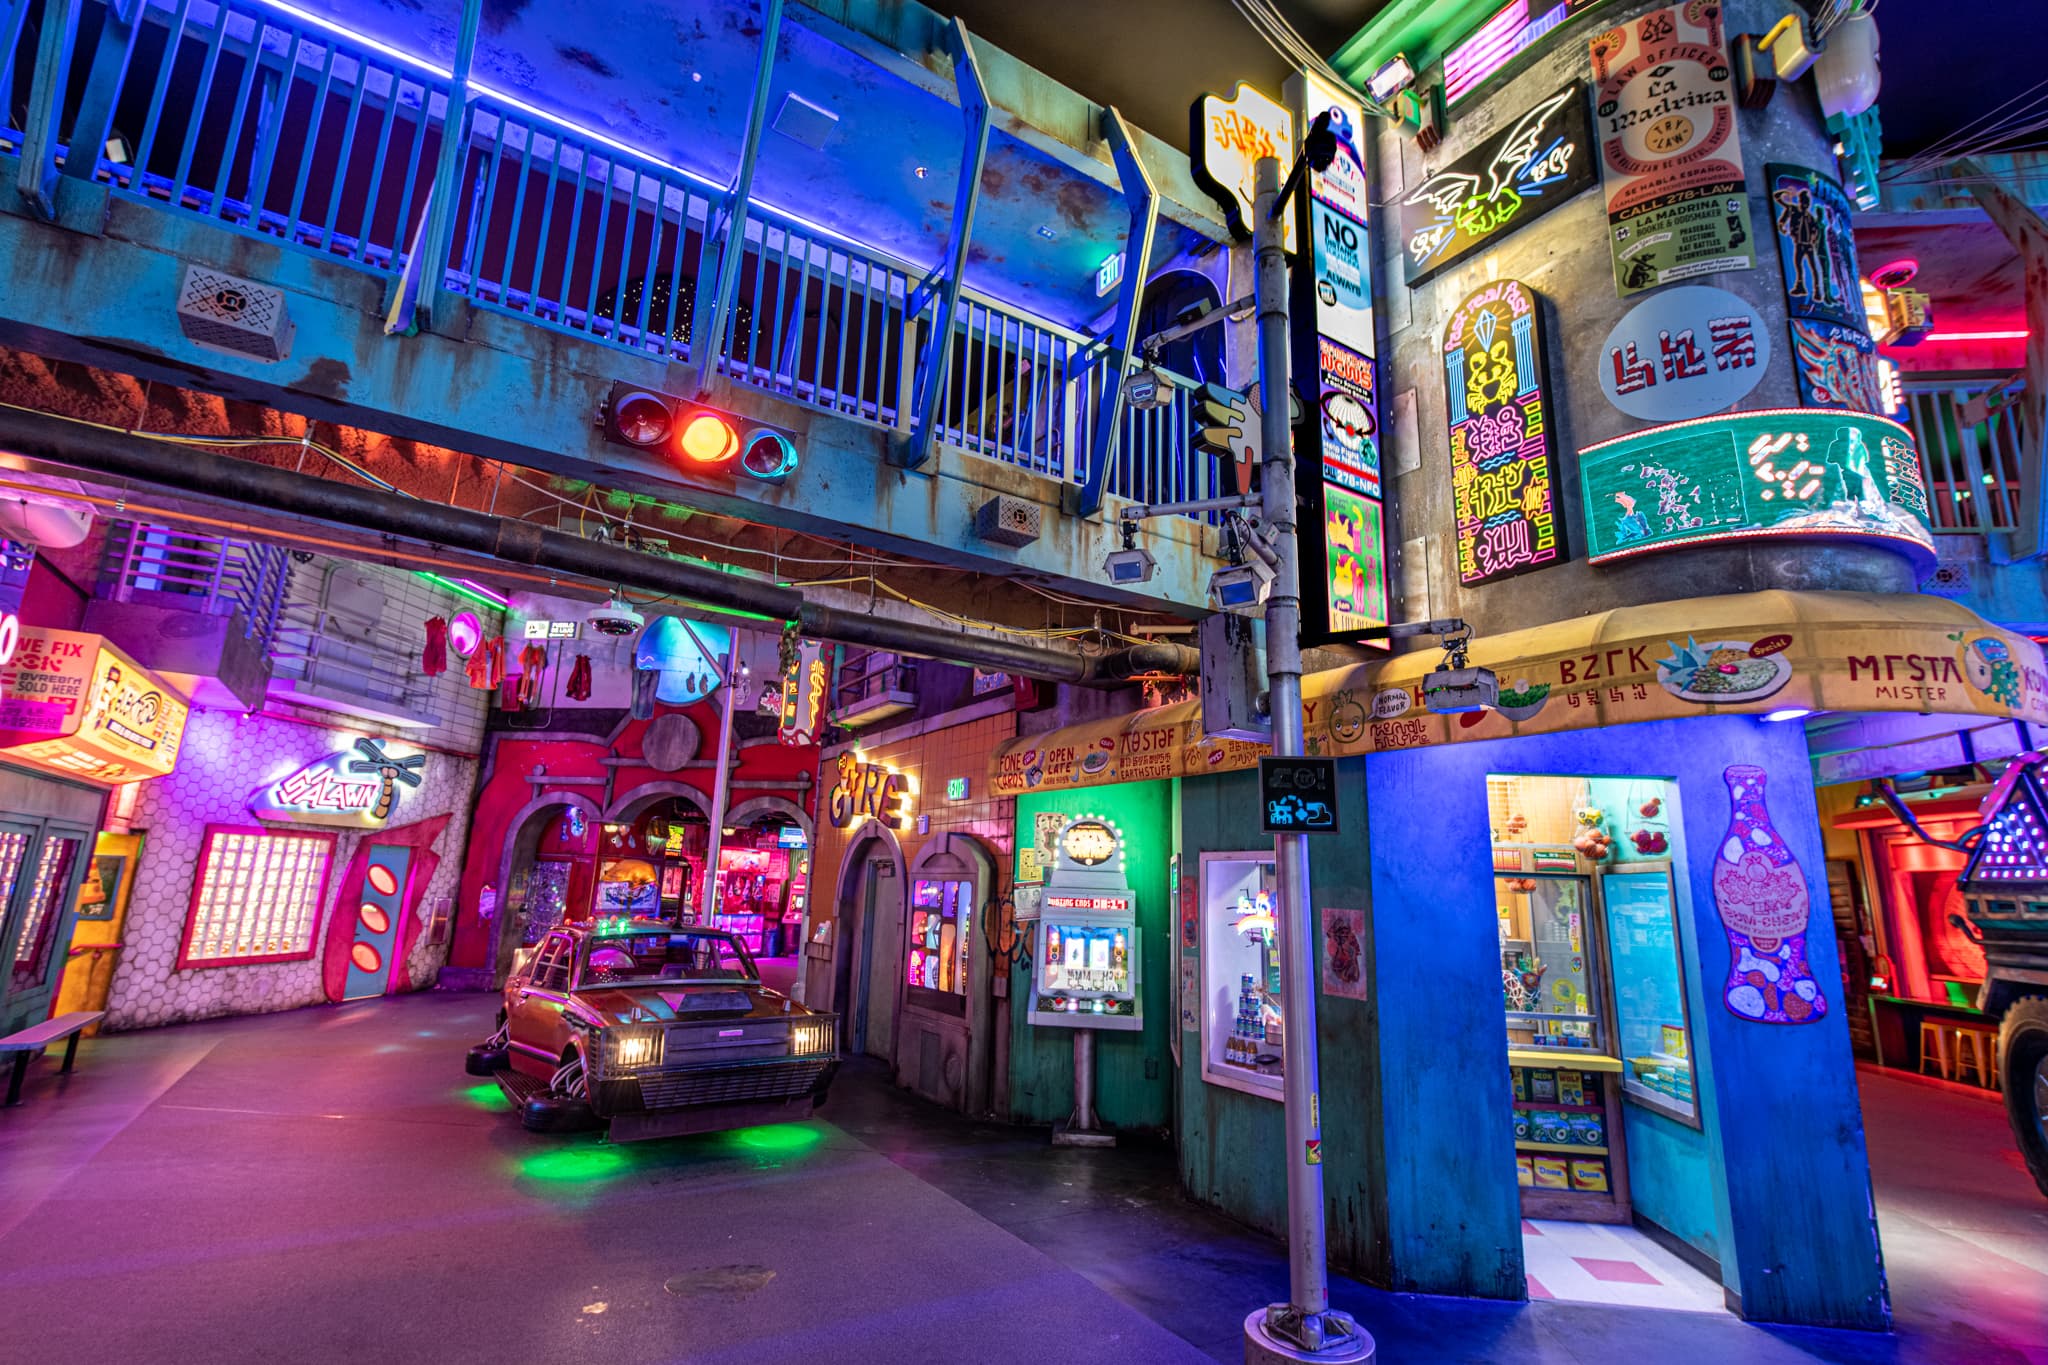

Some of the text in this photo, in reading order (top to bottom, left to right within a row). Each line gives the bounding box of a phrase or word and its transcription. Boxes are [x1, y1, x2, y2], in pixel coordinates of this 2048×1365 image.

[1608, 66, 1638, 96] LAW
[1647, 48, 1717, 66] OFFICES
[1648, 80, 1678, 99] La
[1610, 89, 1727, 133] Madrina
[1654, 119, 1684, 135] TRY
[1640, 175, 1677, 190] HABLA
[1619, 202, 1664, 220] CALL
[1636, 199, 1720, 227] LA MADRINA
[1324, 212, 1358, 250] NO
[1636, 221, 1664, 237] BOOKIE
[1674, 208, 1722, 225] ODDSMAKER
[1681, 231, 1716, 244] ELECTIONS
[1100, 257, 1118, 290] EXIT
[1327, 270, 1361, 297] ALWAYS
[1466, 282, 1505, 314] real
[51, 640, 85, 658] FIX
[16, 682, 81, 696] SOLD HERE
[1876, 686, 1946, 700] MISTER
[1376, 691, 1408, 706] NORMAL
[1377, 700, 1408, 715] FLAVOR
[999, 752, 1021, 775] FONE
[1050, 747, 1074, 762] OPEN
[1047, 761, 1072, 775] LATE
[1120, 766, 1172, 780] EARTHSTUFF
[996, 770, 1024, 790] CARDS
